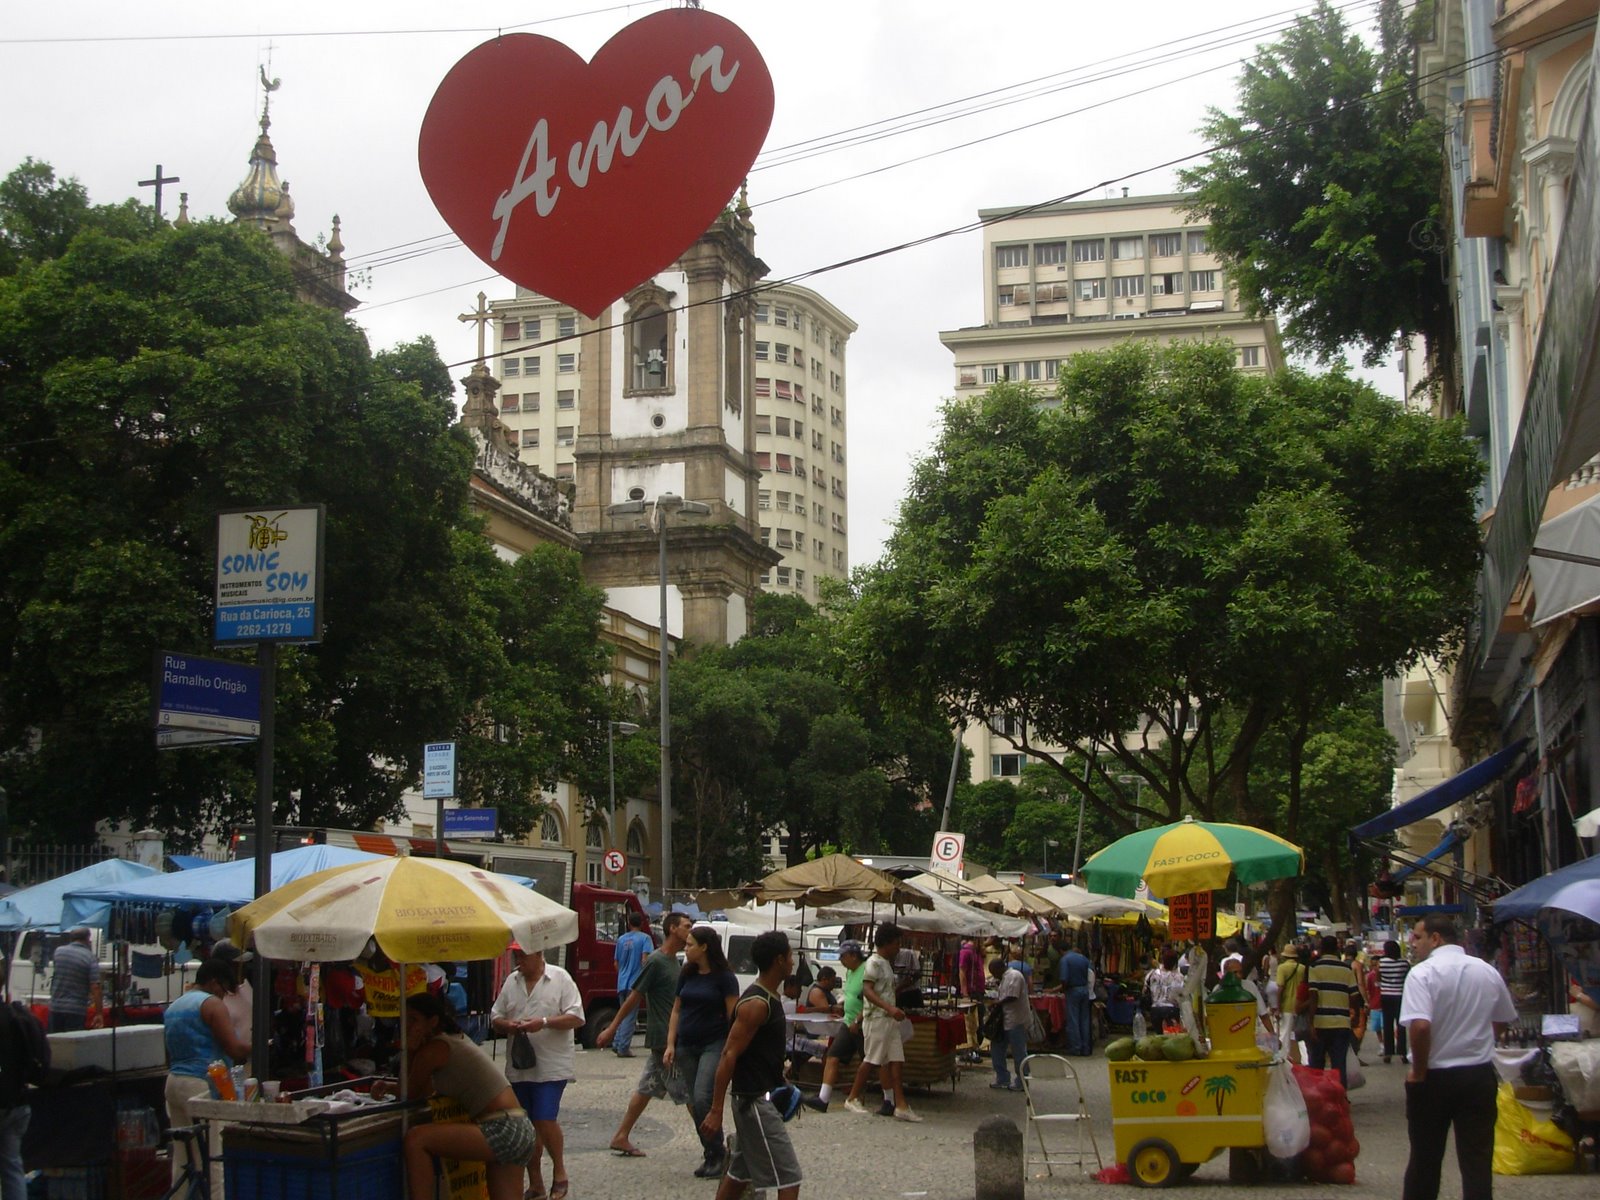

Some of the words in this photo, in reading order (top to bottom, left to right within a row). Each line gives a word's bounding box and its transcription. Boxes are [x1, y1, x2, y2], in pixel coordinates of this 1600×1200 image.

[491, 44, 741, 262] Amor
[221, 551, 280, 576] SONIC
[265, 571, 309, 593] SOM
[220, 589, 248, 598] MUSICAIS
[220, 611, 238, 622] Rua
[240, 609, 251, 620] da
[253, 608, 295, 621] Carioca,
[297, 607, 311, 618] 25
[236, 623, 292, 637] 2262-1279
[165, 655, 186, 670] Rua
[164, 670, 211, 688] Ramalho
[213, 677, 247, 694] Ortigão
[943, 841, 953, 856] E
[1153, 856, 1184, 869] FAST
[1185, 851, 1221, 863] COCO
[1114, 1069, 1149, 1084] FAST
[1130, 1090, 1167, 1104] COCO
